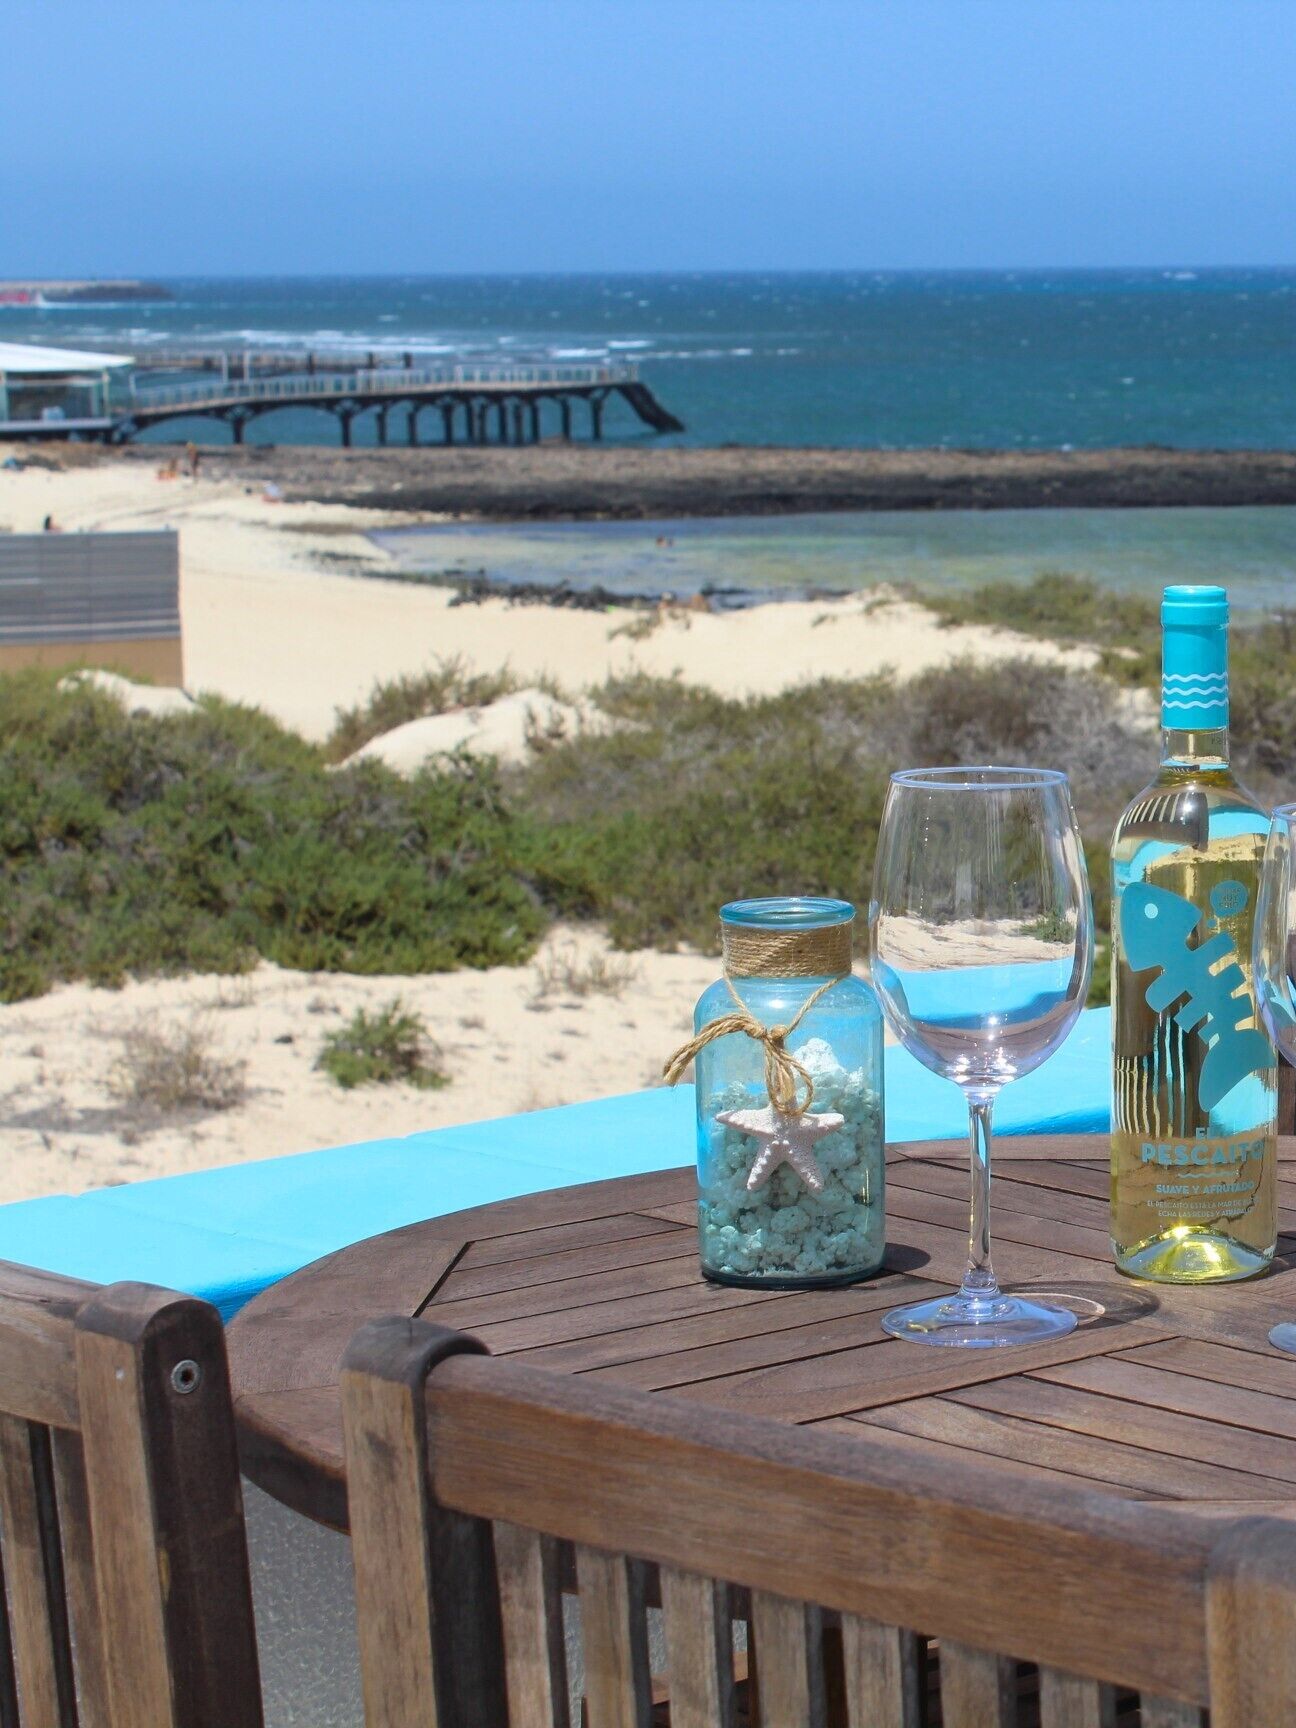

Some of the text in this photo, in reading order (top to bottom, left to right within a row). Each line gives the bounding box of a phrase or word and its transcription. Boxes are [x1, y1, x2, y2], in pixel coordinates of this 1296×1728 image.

[1195, 1127, 1218, 1140] EL
[1141, 1140, 1265, 1165] PESCAITO
[1155, 1180, 1255, 1194] SUAVE Y AFRUTADO
